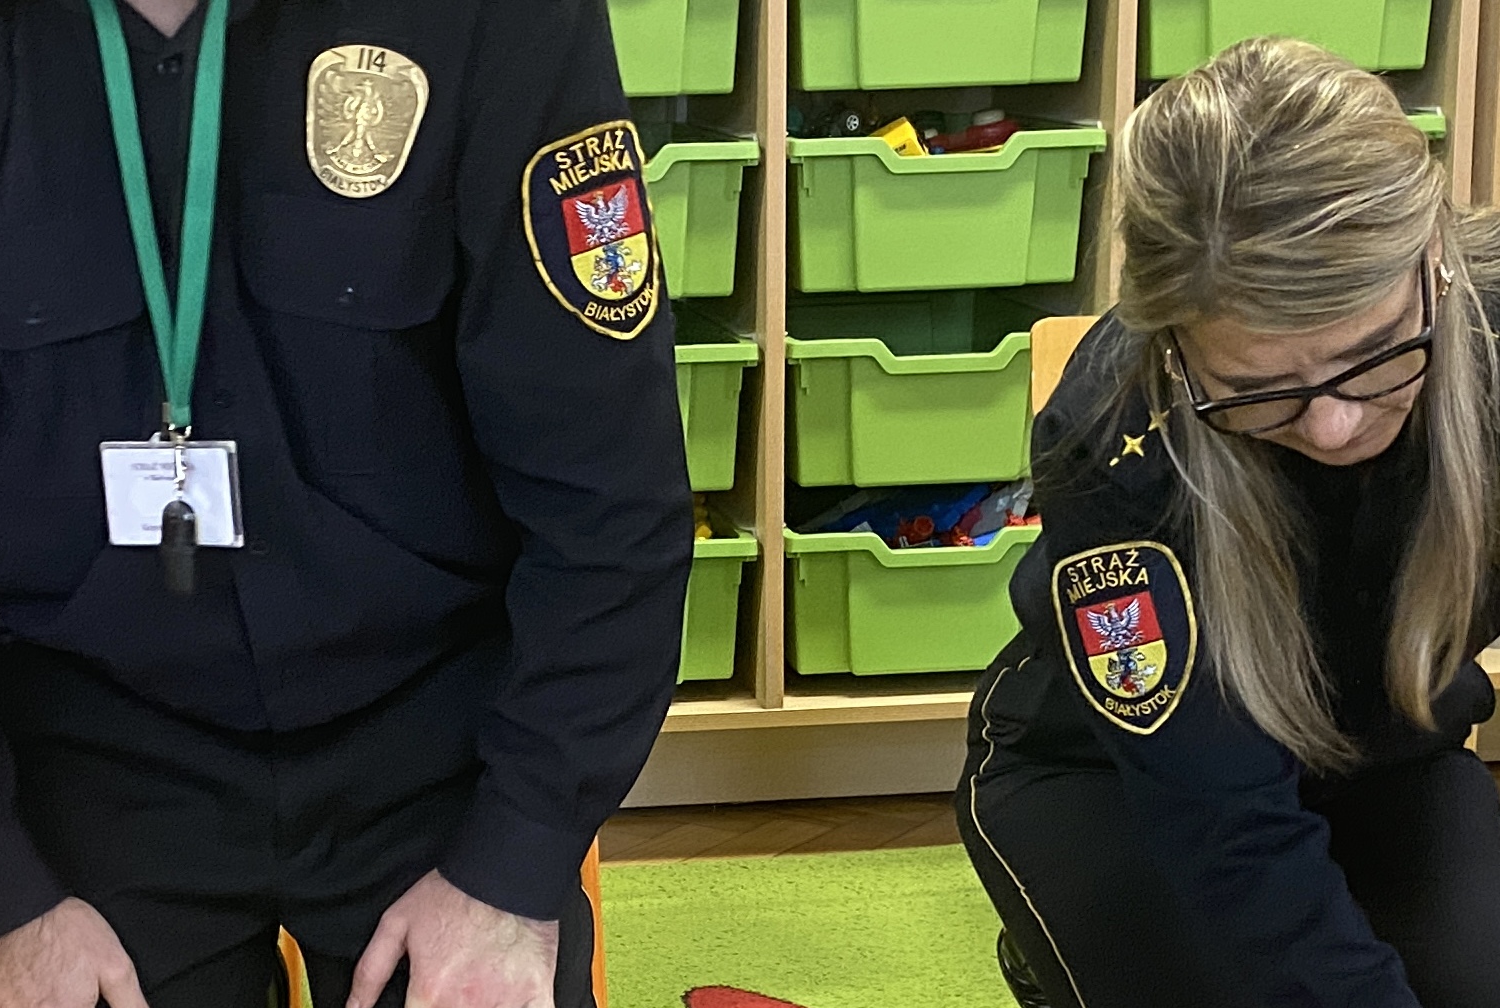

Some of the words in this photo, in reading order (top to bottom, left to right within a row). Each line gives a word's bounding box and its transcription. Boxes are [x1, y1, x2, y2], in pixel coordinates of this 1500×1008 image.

[357, 47, 386, 72] 114
[555, 128, 625, 169] STRAŻ
[549, 150, 635, 195] MIEJSKA
[1067, 548, 1140, 583] STRAŻ
[1066, 567, 1150, 604] MIEJSKA
[1105, 684, 1176, 717] BIAŁYSTOK
